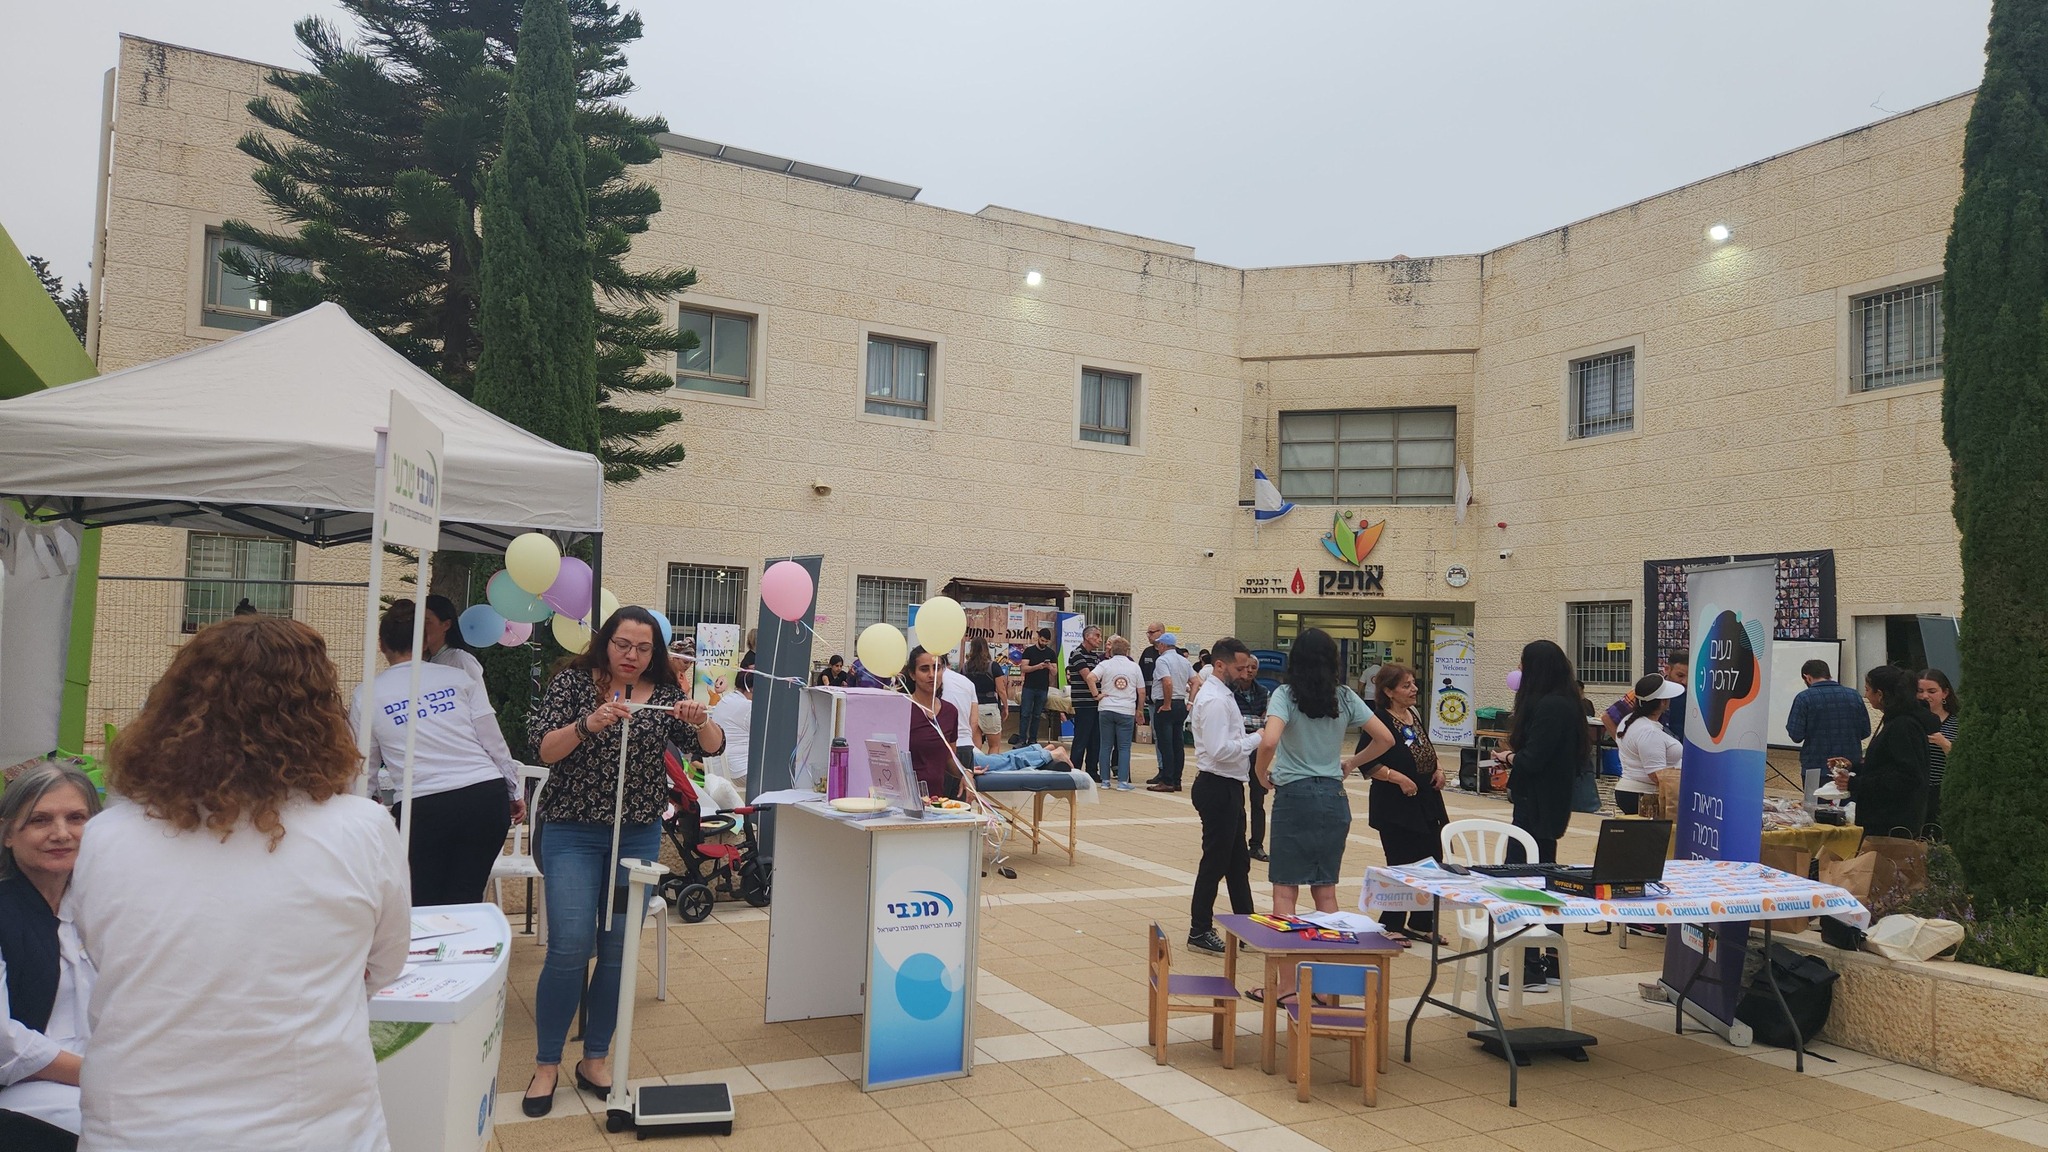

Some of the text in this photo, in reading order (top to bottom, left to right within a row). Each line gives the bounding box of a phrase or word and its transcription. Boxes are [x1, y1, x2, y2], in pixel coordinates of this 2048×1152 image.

[1246, 577, 1269, 586] לבנים
[1318, 570, 1384, 596] אופק
[1239, 586, 1288, 594] חדר הנצחה
[1006, 626, 1034, 640] מלאכה
[702, 648, 734, 657] דיאטנית
[1710, 639, 1733, 661] נעים
[1442, 664, 1468, 672] Welcome
[1709, 667, 1740, 691] להכיר
[424, 688, 456, 703] מכבי
[393, 701, 456, 726] בכל מום
[1691, 791, 1724, 821] בריאות
[1692, 822, 1720, 852] ברמה
[1554, 880, 1573, 889] OFFICE
[887, 900, 940, 919] מכבי
[1726, 904, 1761, 914] מאוחדת
[1777, 901, 1811, 911] מאוחדת
[1497, 908, 1542, 924] מאוחדת
[1560, 907, 1600, 917] מאוחדת
[1618, 907, 1656, 917] מאוחדת
[1673, 907, 1709, 916] מאוחדת
[877, 926, 900, 934] בישראל
[900, 924, 920, 932] הטובה
[944, 921, 962, 929] קבוצת
